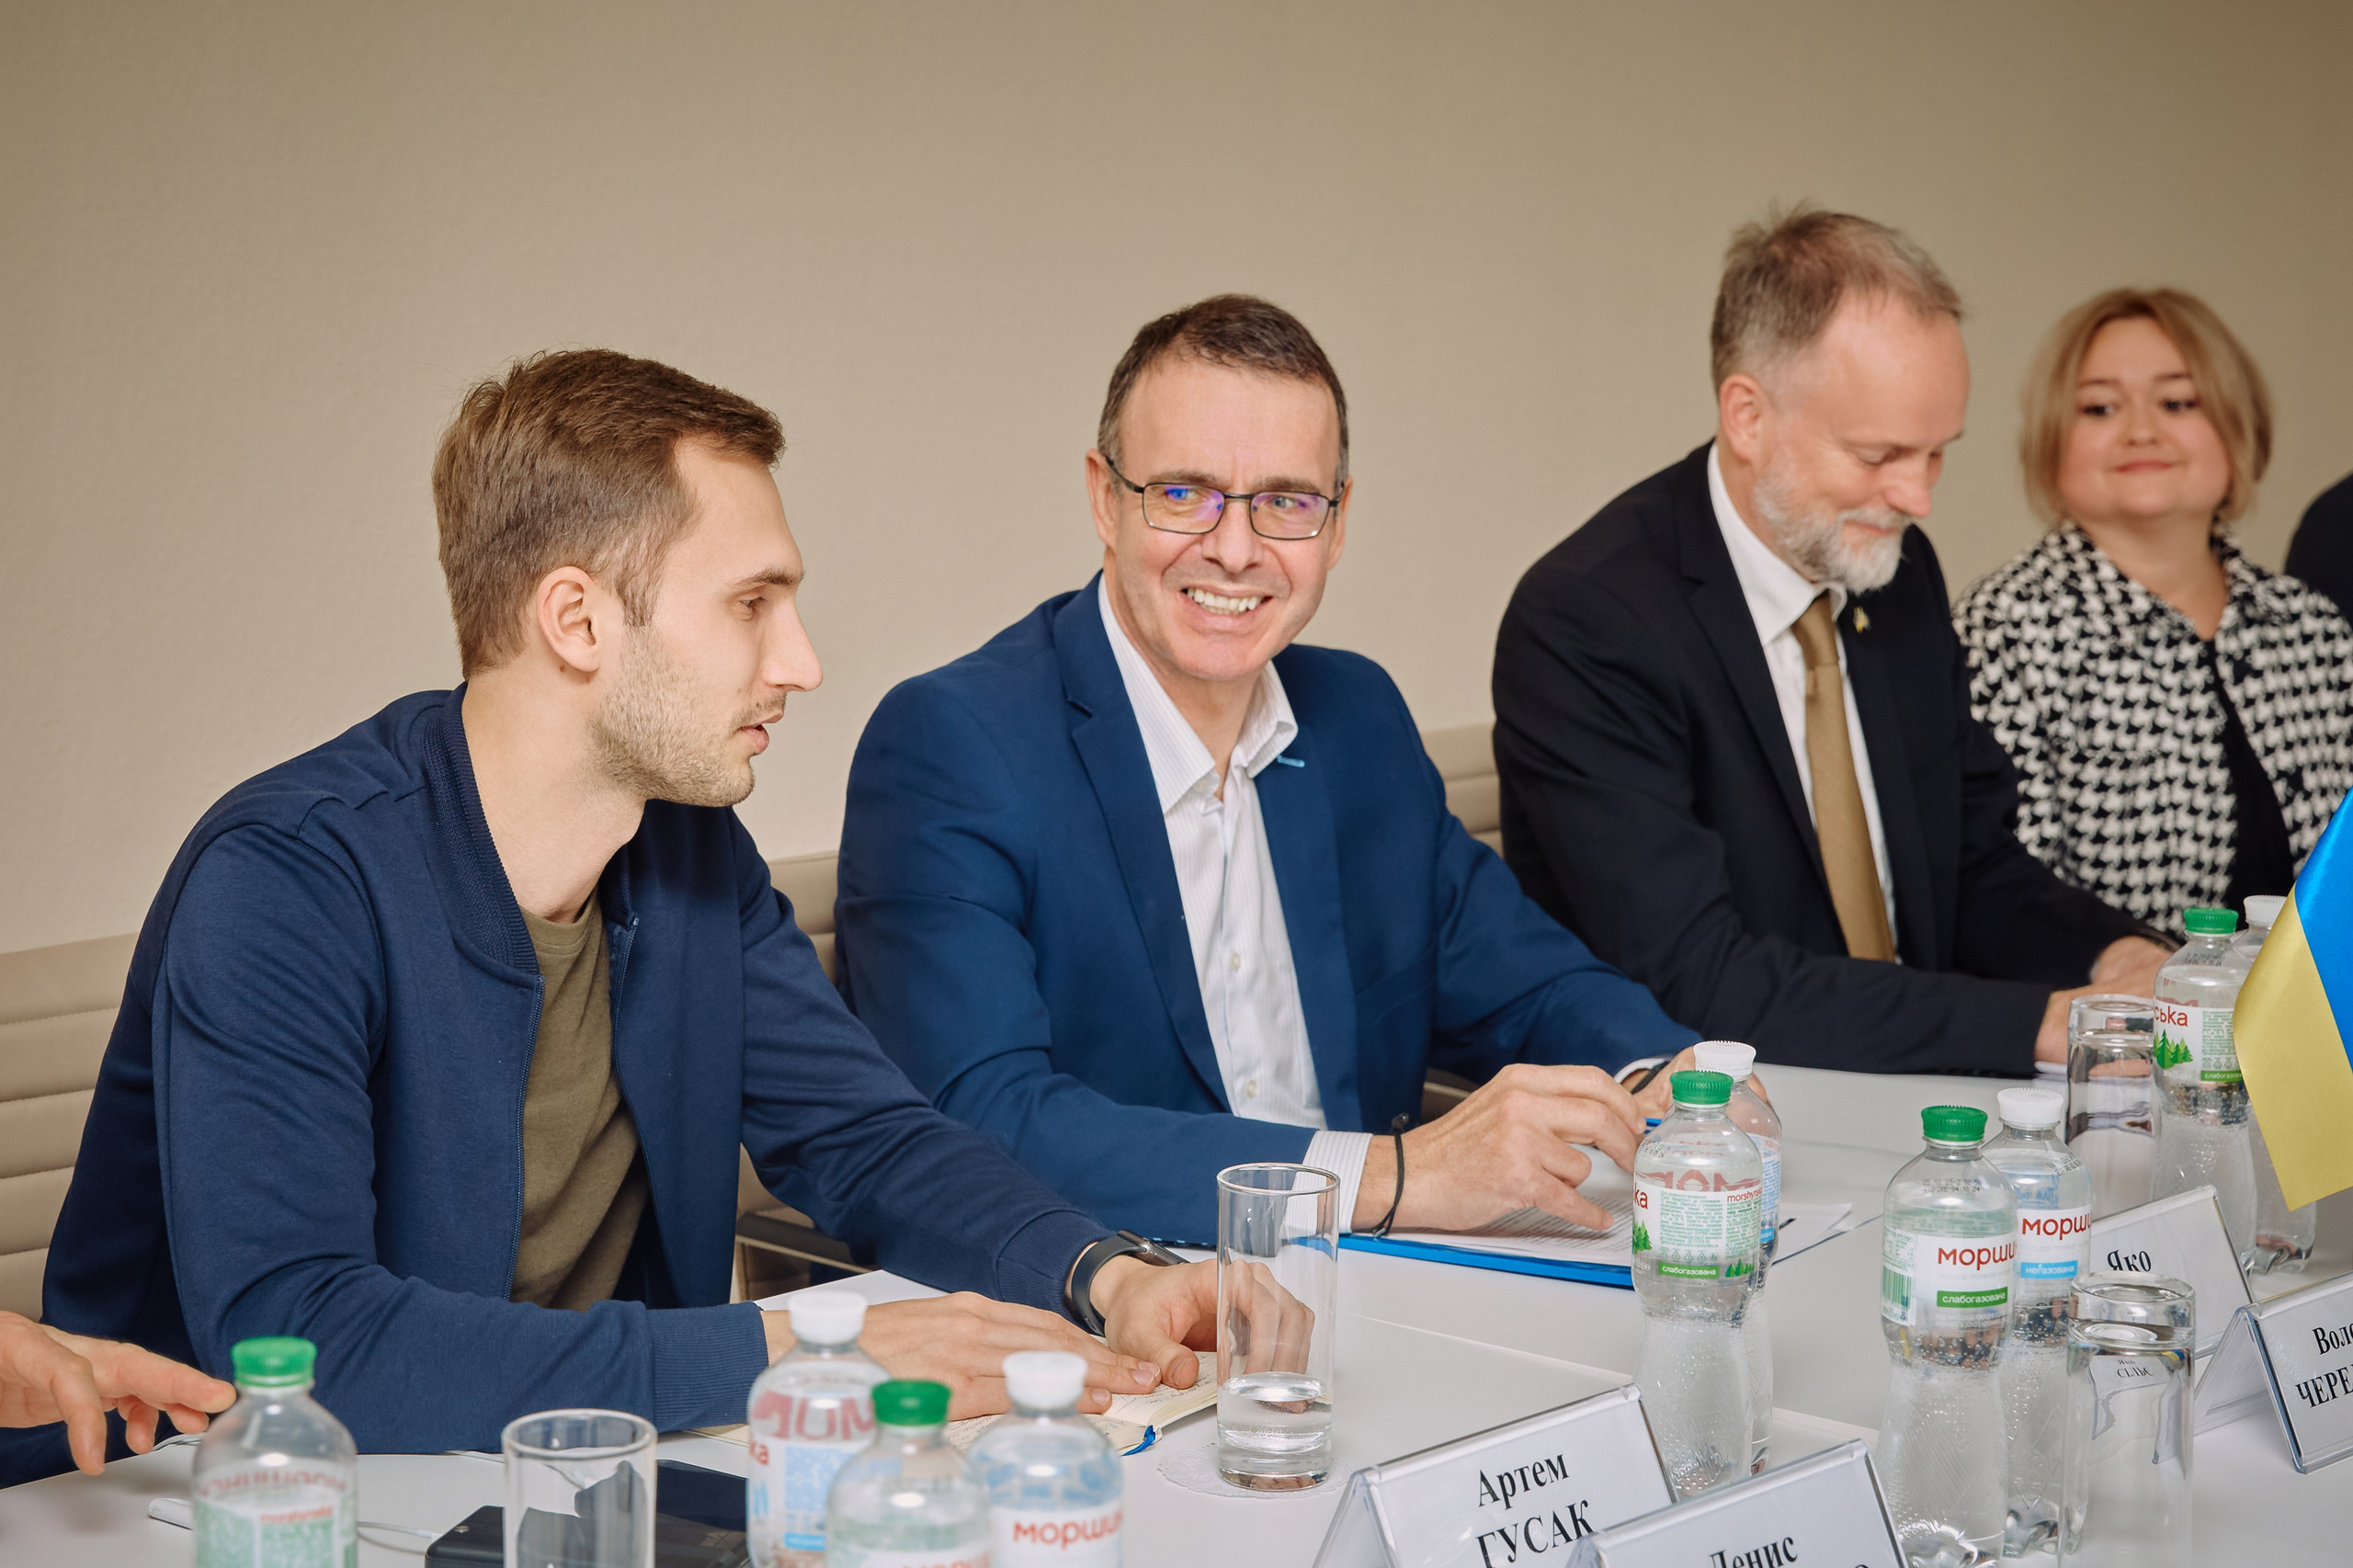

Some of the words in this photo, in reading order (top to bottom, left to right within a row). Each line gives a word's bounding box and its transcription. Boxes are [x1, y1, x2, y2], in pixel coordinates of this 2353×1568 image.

[1662, 1265, 1716, 1276] слабогазована
[1938, 1240, 2017, 1271] морши
[2107, 1249, 2152, 1273] Яко
[1942, 1291, 2006, 1303] слабогазована
[2295, 1364, 2353, 1408] ЧЕРЕ
[1478, 1454, 1569, 1510] Артем
[1474, 1499, 1595, 1568] ГУСАК
